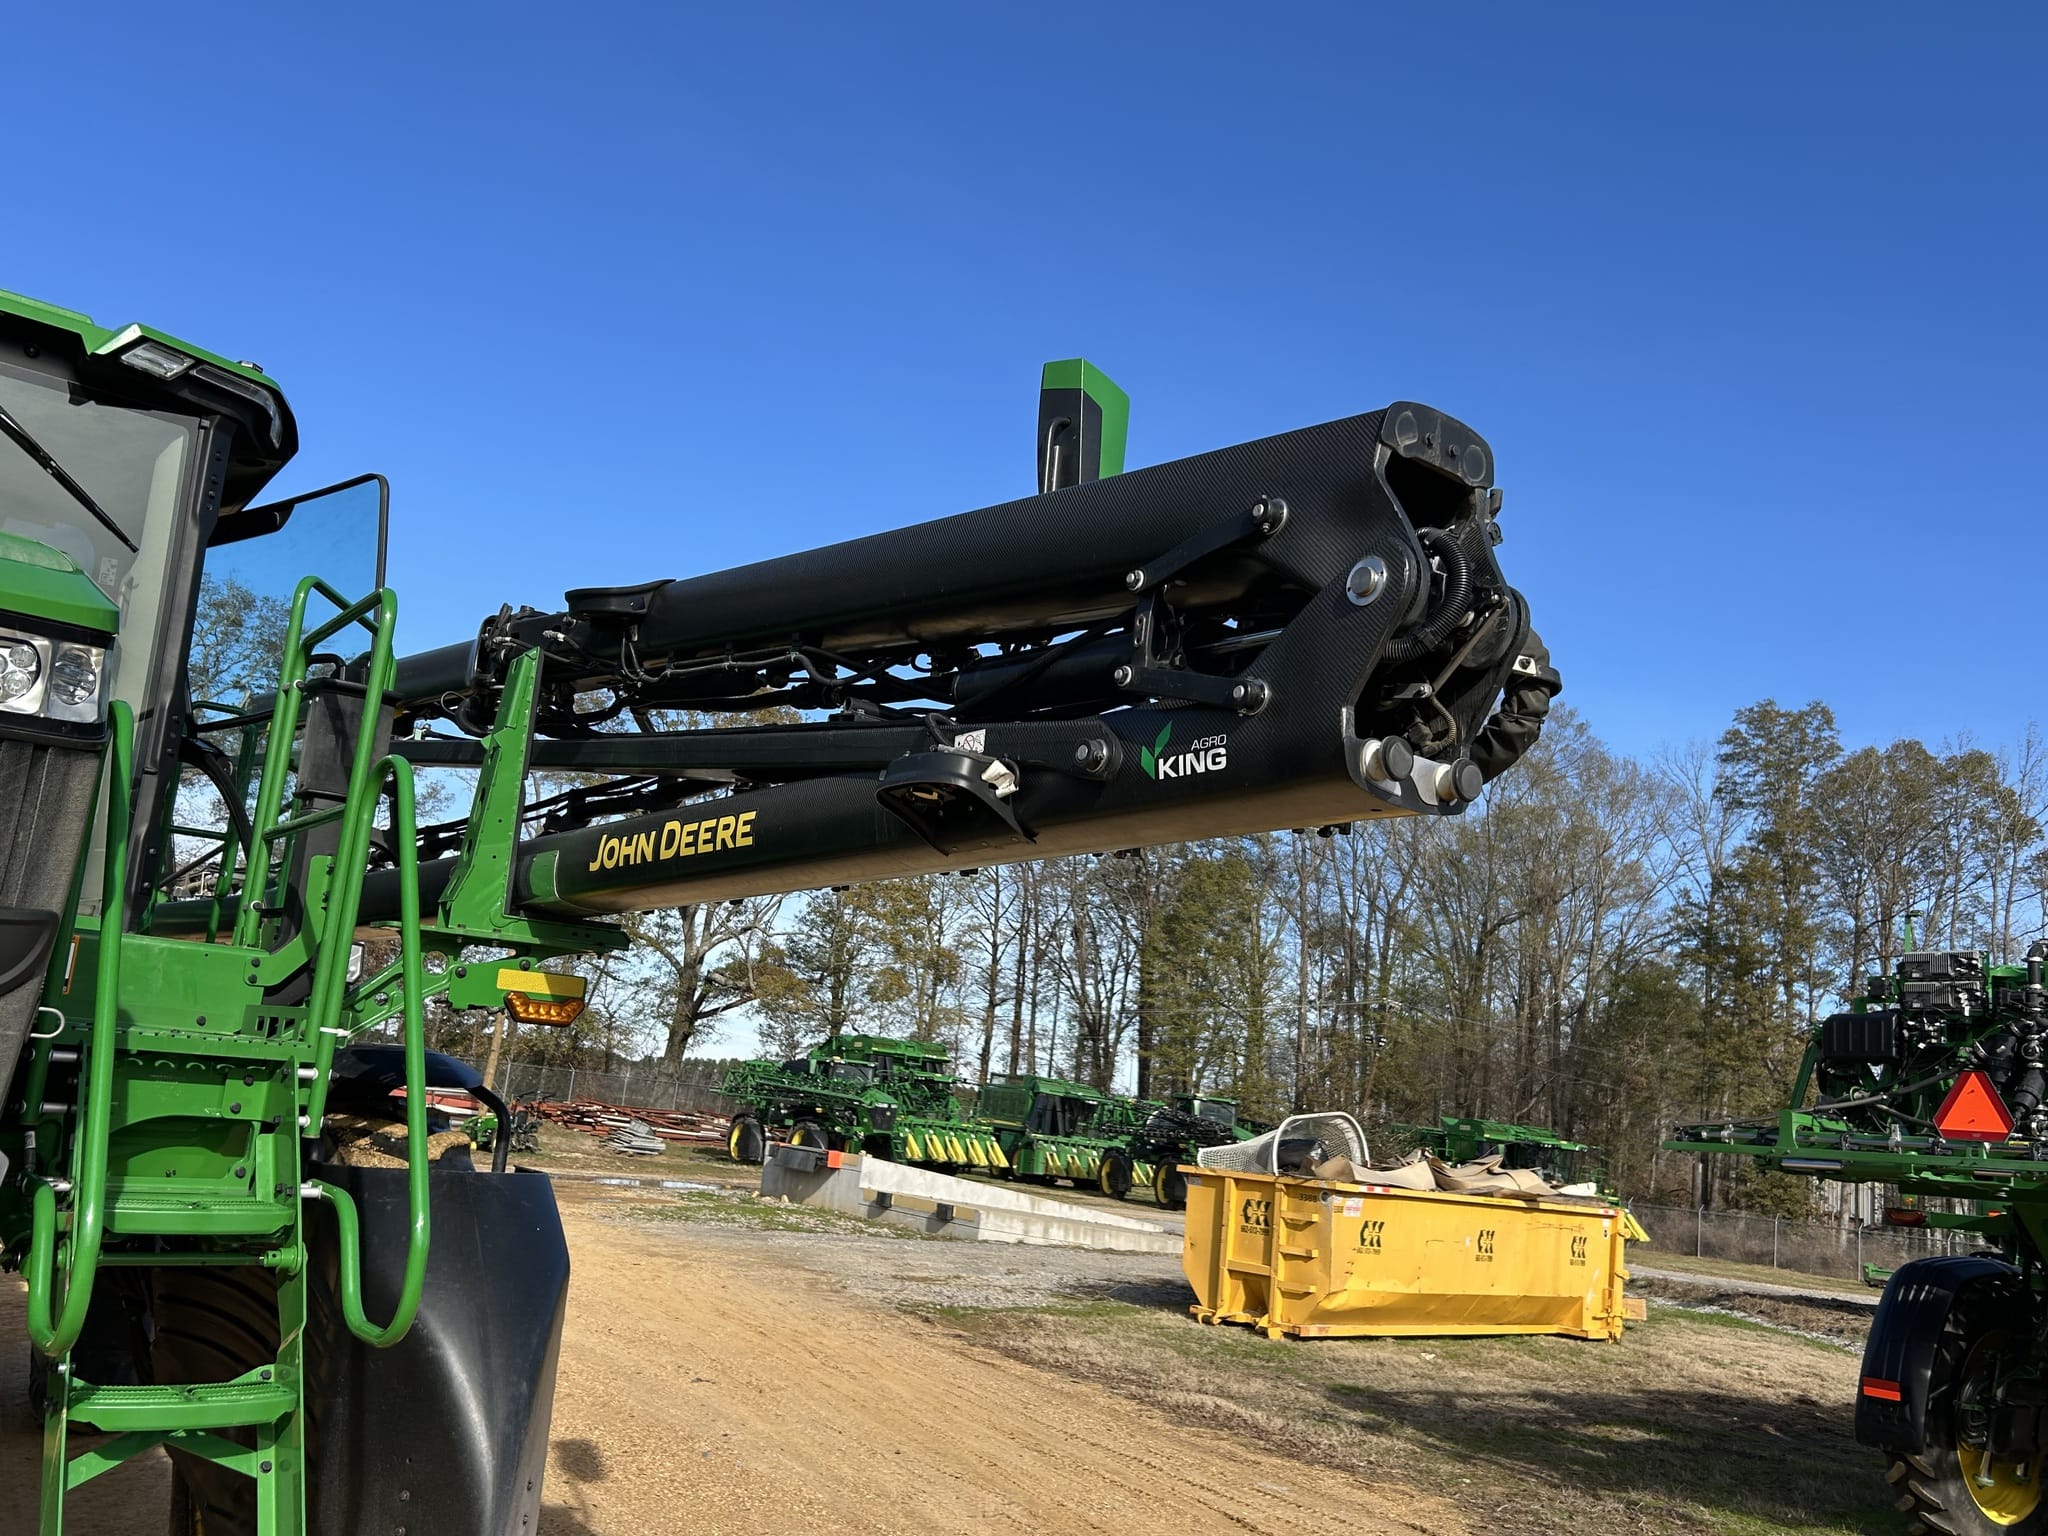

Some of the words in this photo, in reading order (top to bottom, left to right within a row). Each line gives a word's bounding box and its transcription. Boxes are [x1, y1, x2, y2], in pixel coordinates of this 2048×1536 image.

[1190, 734, 1227, 751] AGRO
[1158, 747, 1227, 780] KING
[589, 830, 657, 872] JOHN
[659, 810, 758, 861] DEERE
